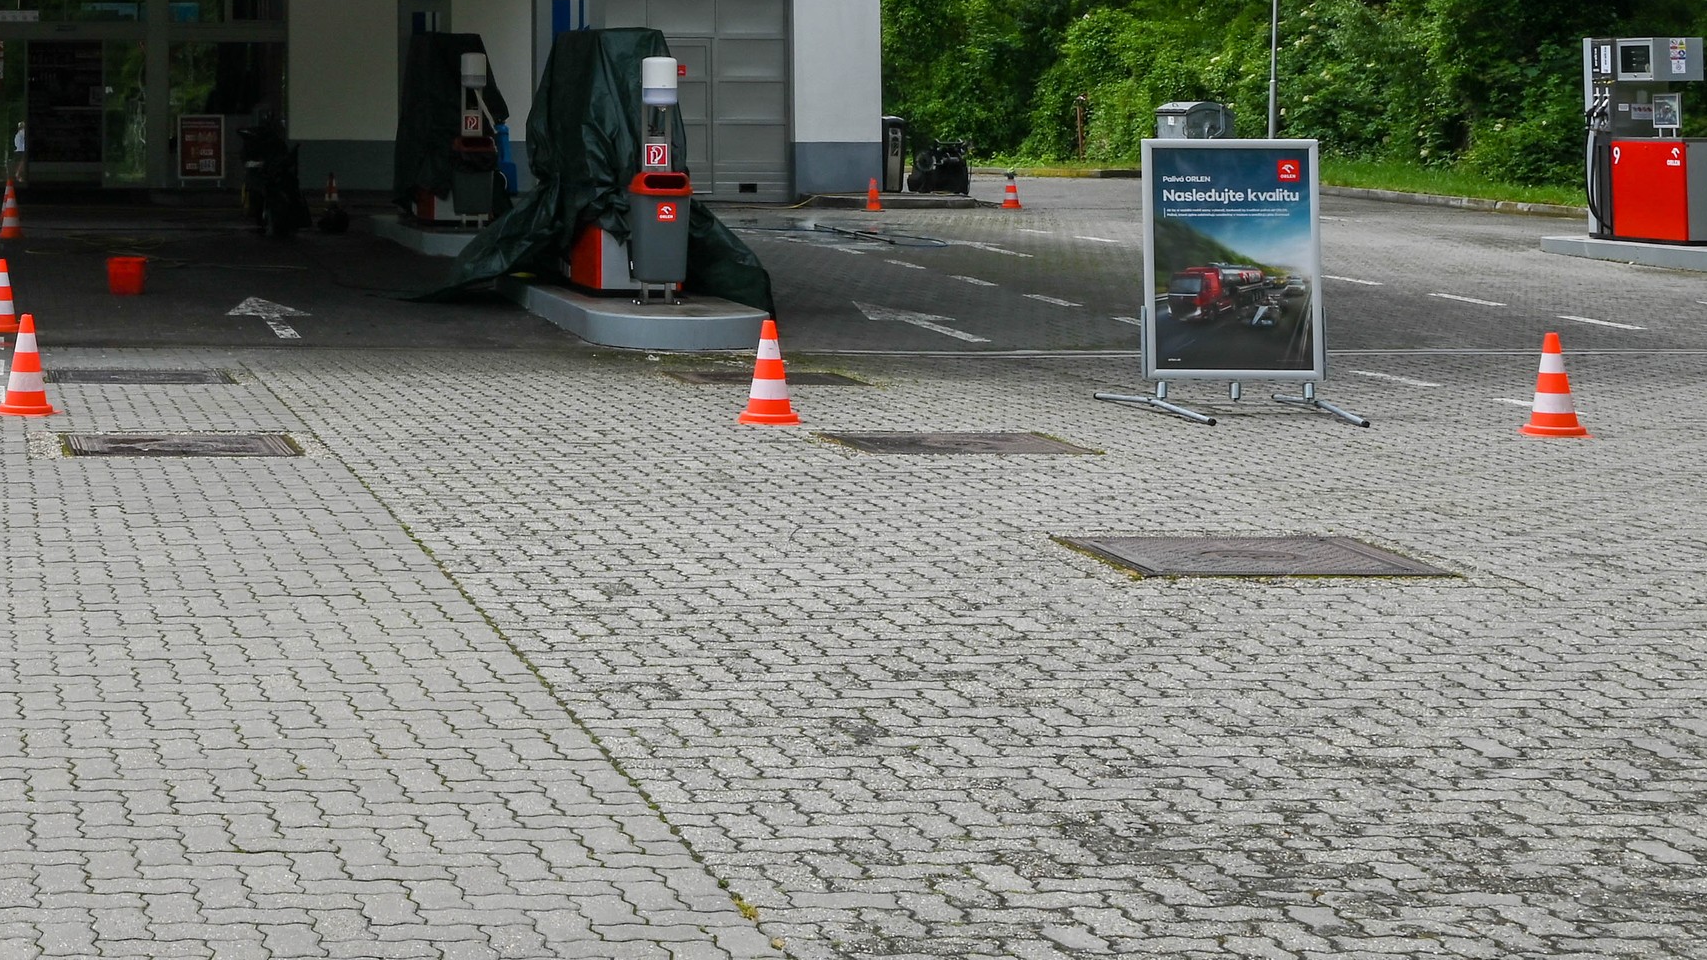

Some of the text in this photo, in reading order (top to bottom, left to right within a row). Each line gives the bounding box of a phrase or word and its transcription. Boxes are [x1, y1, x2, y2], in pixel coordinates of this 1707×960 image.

[1613, 146, 1621, 165] 9
[1162, 175, 1211, 183] Palivá ORLEN
[1162, 188, 1299, 204] Nasledujte kvalitu
